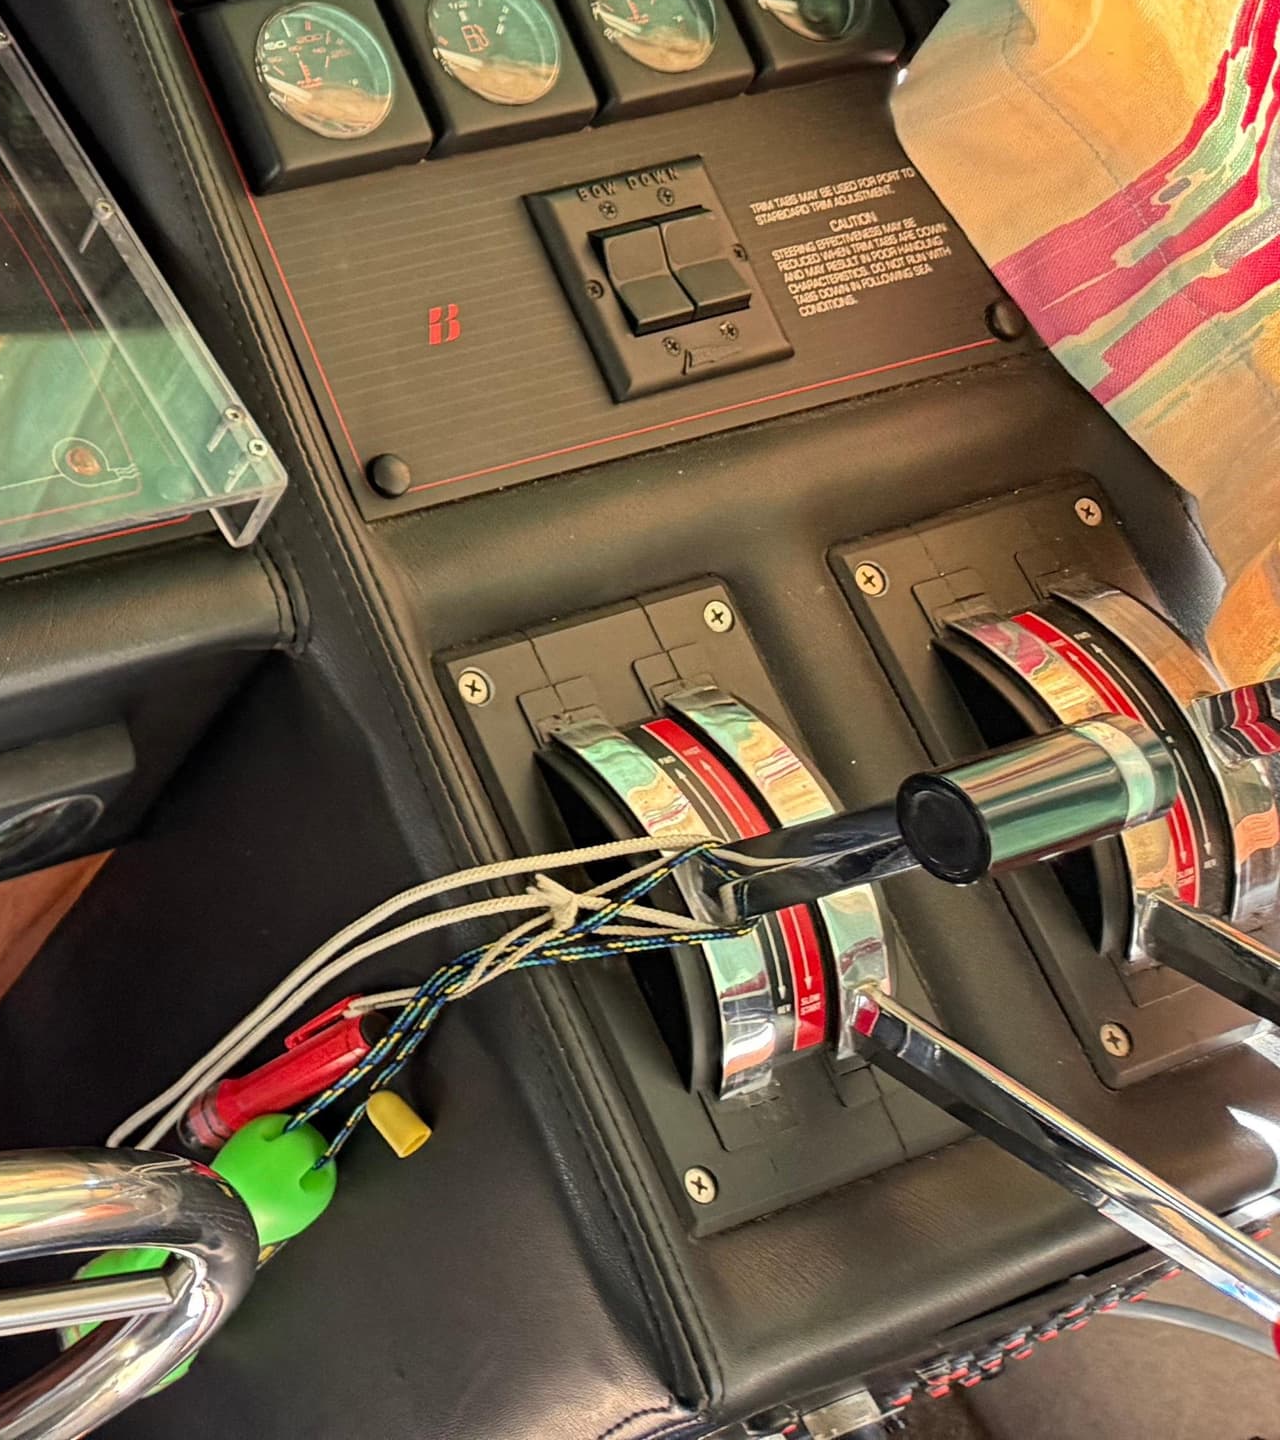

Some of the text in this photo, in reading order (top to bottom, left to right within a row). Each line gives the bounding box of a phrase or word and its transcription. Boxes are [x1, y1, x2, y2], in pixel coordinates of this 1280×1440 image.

[577, 167, 680, 201] BOW DOWN
[829, 212, 878, 233] CAUTION
